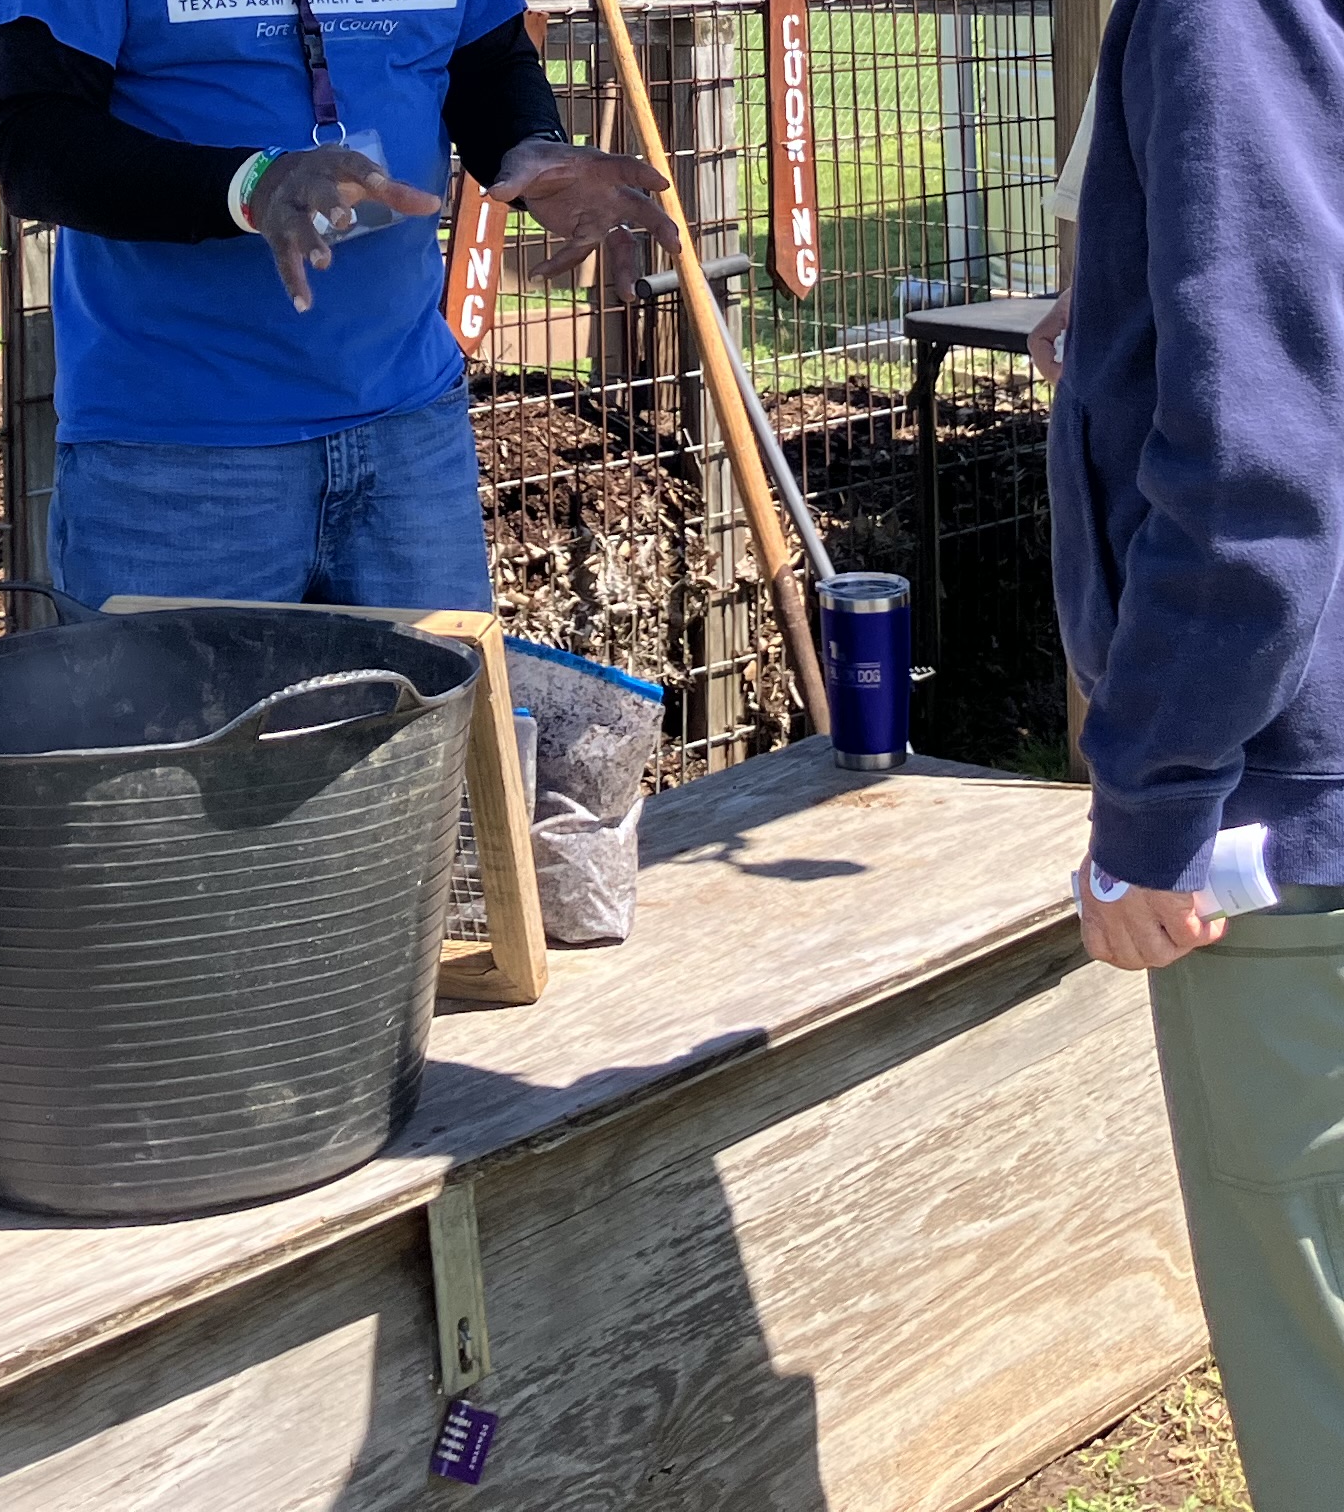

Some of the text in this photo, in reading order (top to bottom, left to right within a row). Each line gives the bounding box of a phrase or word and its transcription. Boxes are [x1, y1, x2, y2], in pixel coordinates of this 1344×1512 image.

[256, 21, 290, 39] Fort
[339, 17, 400, 38] County
[780, 13, 819, 288] COOKING
[460, 185, 493, 340] ING
[857, 669, 881, 684] DOG
